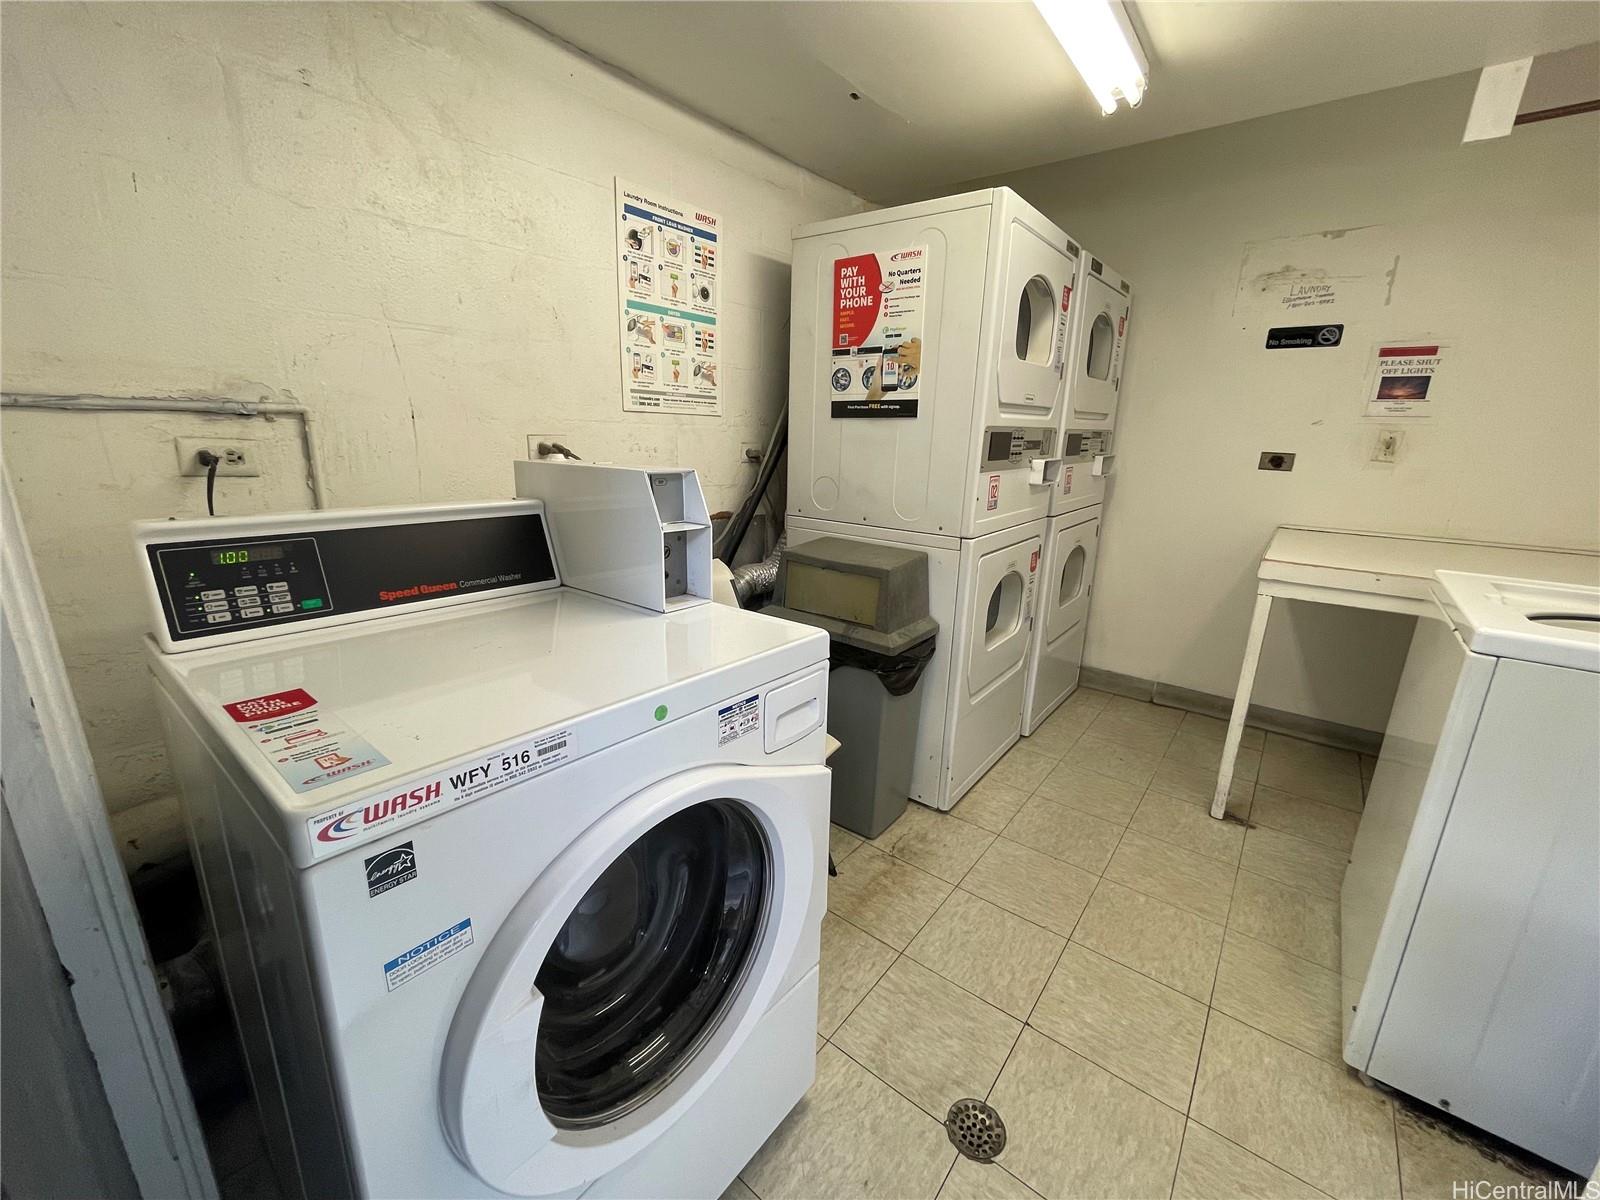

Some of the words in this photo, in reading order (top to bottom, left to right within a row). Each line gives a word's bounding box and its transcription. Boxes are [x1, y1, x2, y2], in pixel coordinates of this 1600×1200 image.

[624, 191, 643, 203] Laundry
[644, 198, 657, 208] Room
[658, 203, 684, 217] Instructions
[652, 215, 666, 224] FRONT
[695, 211, 717, 226] WASH
[900, 250, 922, 259] WASH
[841, 266, 859, 278] PAY
[897, 267, 921, 277] Quarters
[840, 275, 865, 288] WITH
[899, 276, 921, 286] Needed
[840, 286, 866, 299] YOUR
[1290, 284, 1332, 296] LAUNDRY
[840, 296, 873, 309] PHONE
[1280, 337, 1313, 346] Smoking
[1380, 359, 1415, 367] PLEASE
[1415, 358, 1443, 366] SHUT
[1400, 367, 1436, 375] LIGHTS
[458, 575, 499, 588] Commercial
[498, 572, 522, 583] Washer
[378, 586, 420, 601] Speed
[420, 581, 458, 595] Queen
[243, 700, 302, 717] PHONE
[449, 763, 491, 790] WFY
[502, 750, 530, 771] 516
[362, 781, 441, 825] WASH
[313, 812, 338, 825] PROPERTY
[363, 817, 395, 832] multifamily
[397, 809, 417, 819] laundry
[419, 799, 440, 810] systems
[369, 877, 398, 896] ENERGY
[399, 871, 417, 883] STAR
[398, 925, 461, 965] NOTICE
[389, 964, 406, 977] DOOR
[407, 954, 423, 966] LOCK
[423, 945, 439, 957] LIGHT
[407, 954, 432, 972] attempting
